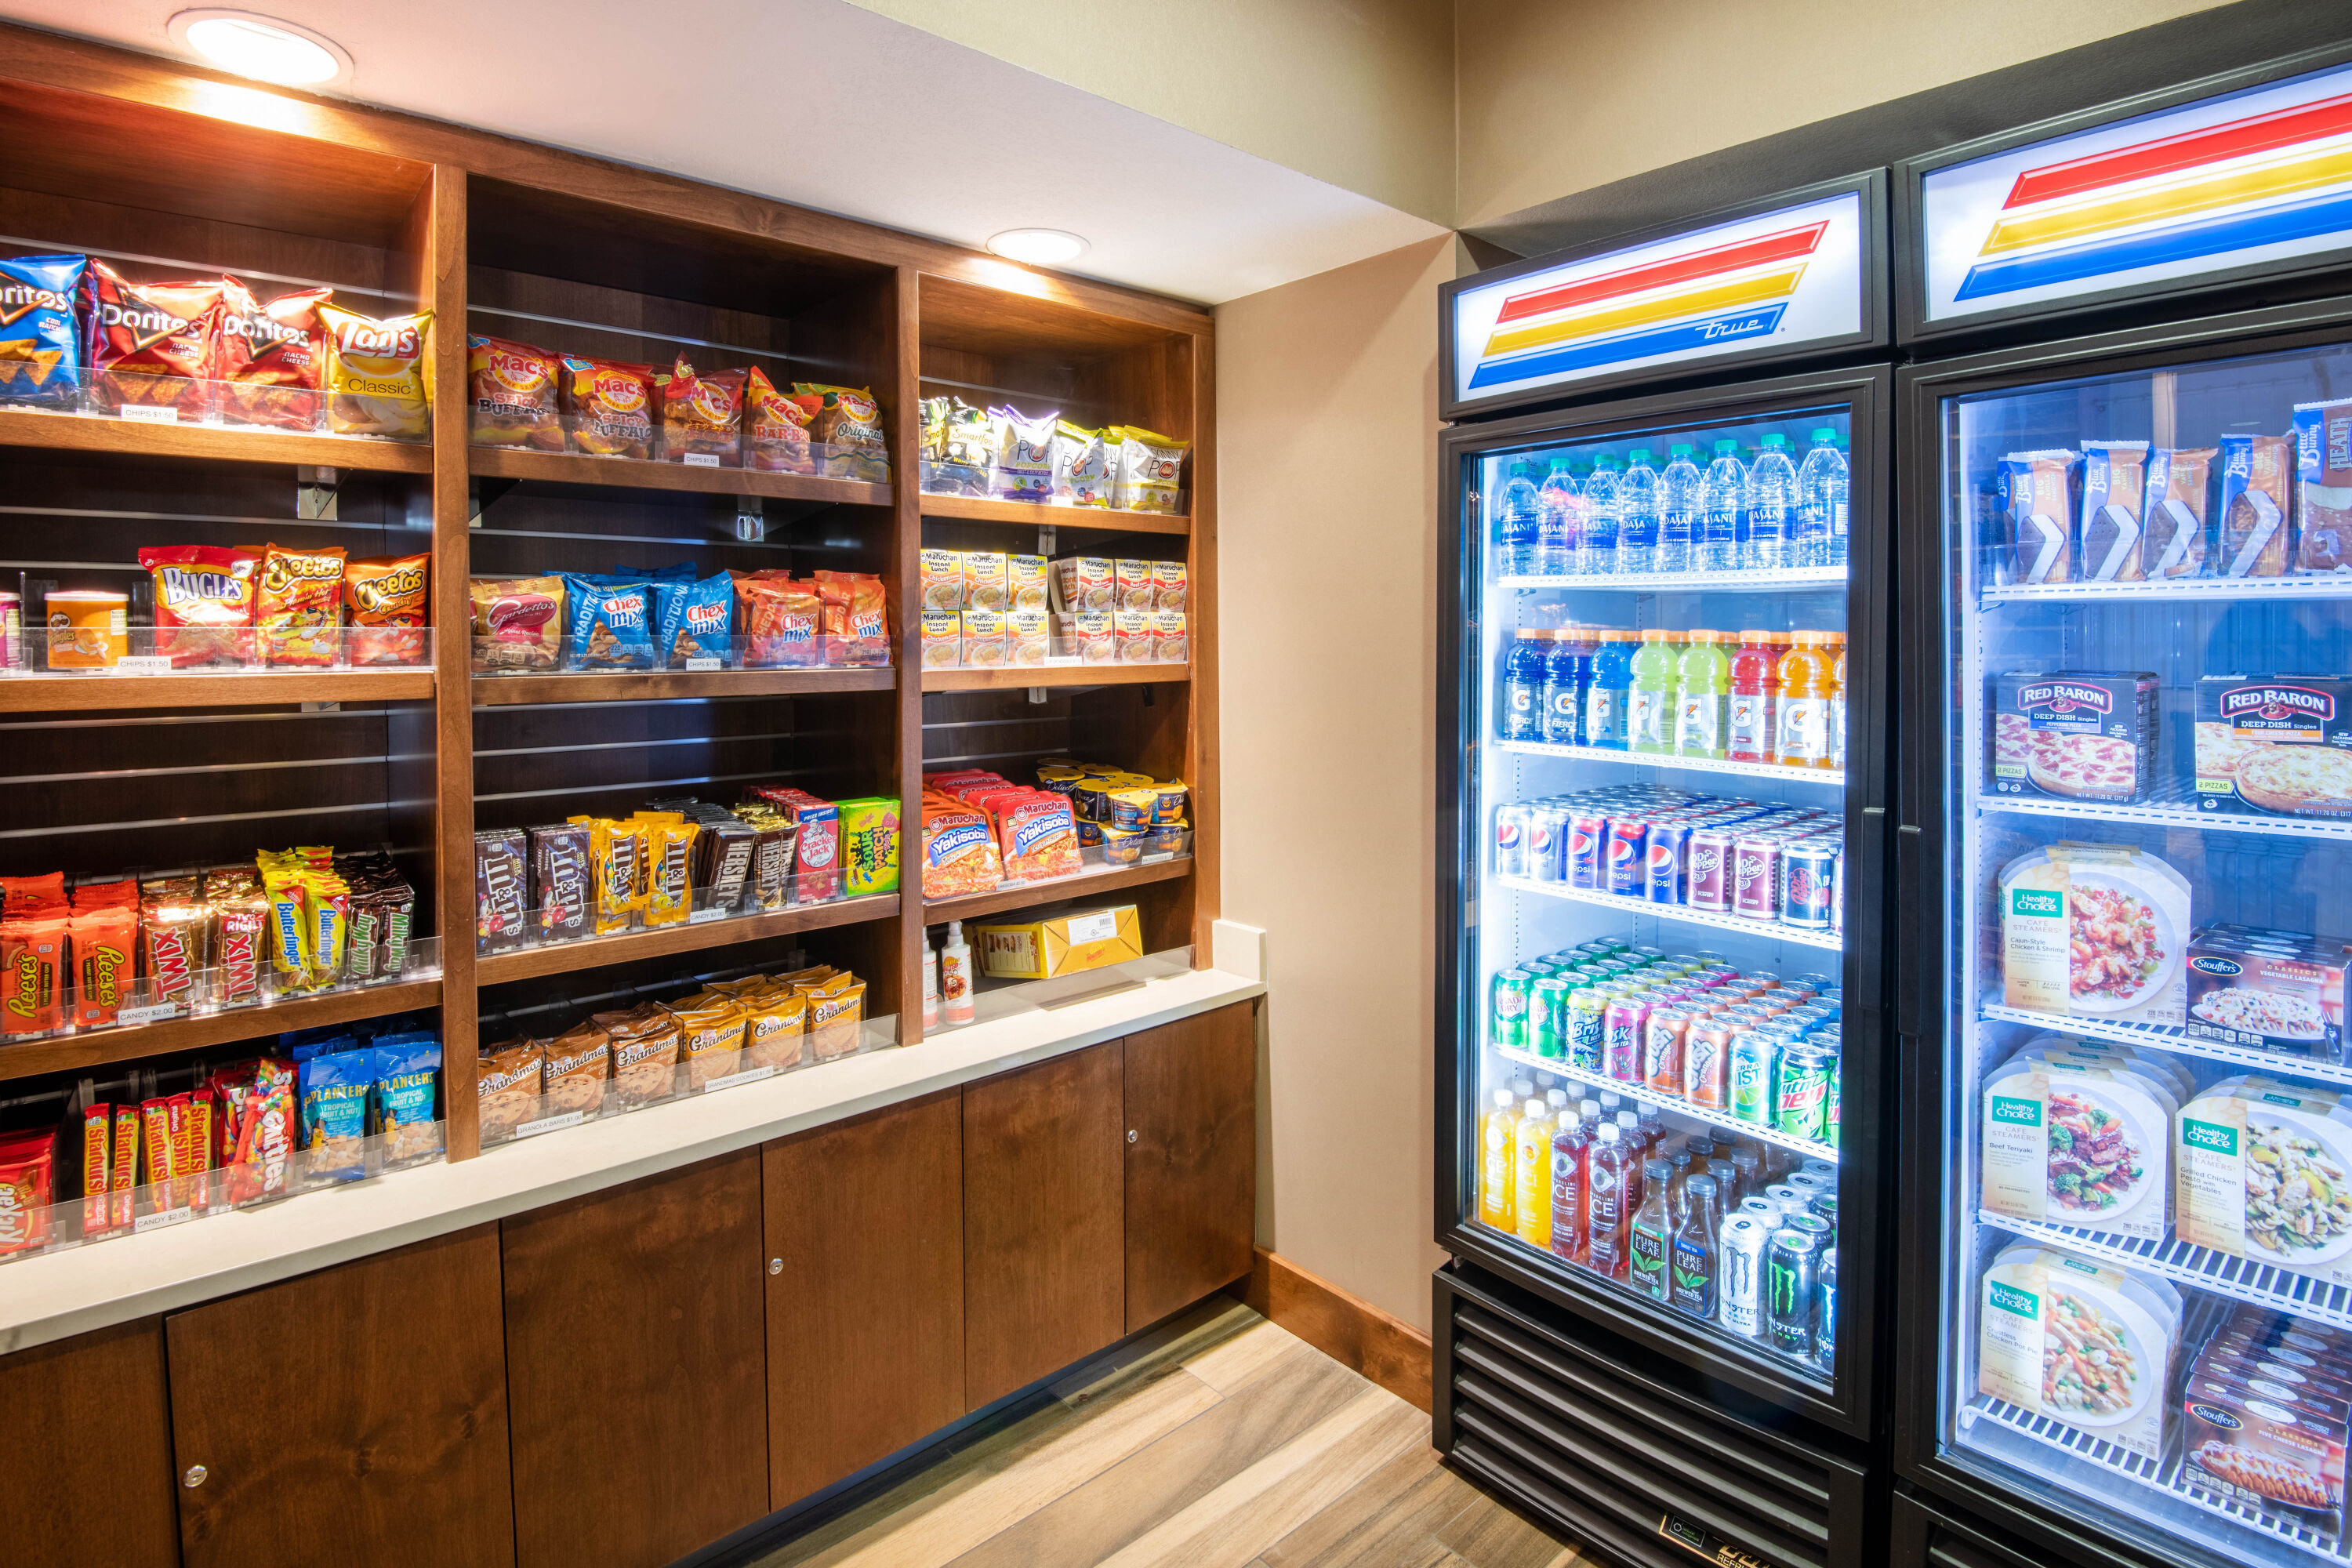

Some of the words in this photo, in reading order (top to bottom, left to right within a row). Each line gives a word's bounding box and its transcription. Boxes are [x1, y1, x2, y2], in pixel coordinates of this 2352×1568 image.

[102, 303, 202, 338] Doritos
[223, 315, 310, 346] Doritos
[281, 357, 310, 366] CHEESE
[488, 354, 549, 379] Mac's
[348, 379, 412, 396] Classic
[592, 378, 647, 398] Mac's
[760, 394, 803, 426] Mac's
[837, 392, 877, 412] Mac's
[125, 408, 151, 417] CHIPS
[601, 414, 644, 426] SPICY
[837, 422, 884, 441] Original
[926, 553, 958, 562] Maruchan
[1086, 560, 1111, 568] Maruchan
[161, 567, 243, 605] BUGLES
[354, 568, 424, 612] Cheetos
[379, 595, 413, 614] Crunchy
[604, 596, 643, 614] Chex
[687, 601, 727, 621] Chex
[486, 599, 554, 635] Gardetto's
[781, 613, 817, 631] Chex
[851, 611, 881, 628] Chex
[2024, 688, 2052, 703] RED
[2053, 685, 2105, 706] BARON
[2229, 693, 2262, 710] RED
[2263, 690, 2325, 711] BARON
[1025, 802, 1068, 814] Maruchan
[804, 813, 817, 822] PRIZE
[939, 815, 985, 825] Maruchan
[1018, 816, 1070, 844] Yakisoba
[800, 835, 837, 853] Cracker
[873, 826, 884, 870] PATCH
[931, 828, 987, 855] Yakisoba
[807, 846, 829, 861] Jack
[862, 831, 873, 871] SOUR
[715, 840, 755, 909] HERSHEY'S
[761, 841, 781, 898] HERSHEY'S
[2017, 902, 2056, 912] Choice
[2022, 895, 2056, 906] Healthy
[277, 902, 301, 967] Butterfinger
[316, 909, 336, 965] Butterfinger
[2013, 924, 2060, 934] STEAMERS
[2010, 937, 2045, 946] Cajun-Style
[2042, 945, 2066, 954] Shrimp
[2197, 959, 2237, 973] Stouffer's
[2259, 970, 2294, 980] VEGETABLE
[2267, 964, 2318, 976] CLASSICS
[7, 953, 38, 1018] Reese's
[96, 946, 125, 1007] Reese's
[120, 1010, 149, 1020] CANDY
[151, 1007, 173, 1016] $2.00
[689, 1022, 746, 1052] Grandma's
[615, 1035, 678, 1067] Grandma's
[1658, 1044, 1671, 1069] Orange
[546, 1044, 609, 1079] Grandma's
[1699, 1058, 1713, 1083] Orange
[379, 1072, 434, 1092] PLANTERS
[477, 1058, 542, 1097] Grandma's
[706, 1078, 735, 1089] GRANDMAS
[310, 1085, 369, 1102] PLANTERS
[393, 1088, 423, 1099] TROPICAL
[323, 1101, 355, 1110] TROPICAL
[1996, 1108, 2036, 1120] Choice
[2001, 1101, 2034, 1113] Healthy
[517, 1123, 547, 1135] GRANOLA
[549, 1118, 566, 1128] BARS
[566, 1114, 583, 1123] $1.00
[2193, 1125, 2230, 1140] Healthy
[149, 1115, 172, 1182] Starburst
[2006, 1145, 2033, 1154] Teriyaki
[2187, 1132, 2230, 1149] Choice
[88, 1127, 107, 1195] Starburst
[115, 1123, 135, 1189] Starburst
[2180, 1167, 2205, 1178] Grilled
[2207, 1174, 2237, 1185] Chicken
[2180, 1173, 2201, 1184] Pesto
[2180, 1181, 2222, 1196] Vegetables
[123, 1194, 132, 1224] Original
[1591, 1196, 1615, 1217] ICE
[137, 1216, 166, 1228] CANDY
[168, 1210, 189, 1221] $2.00
[1635, 1242, 1660, 1257] LEAF
[1636, 1234, 1660, 1248] PURE
[1676, 1250, 1703, 1265] PURE
[1677, 1258, 1702, 1272] LEAF
[1650, 1276, 1659, 1285] TEA
[1676, 1287, 1693, 1299] BREWED
[1693, 1294, 1703, 1303] TEA
[1994, 1294, 2033, 1314] Choice
[1998, 1287, 2032, 1305] Healthy
[1987, 1326, 2016, 1340] Crustless
[1987, 1332, 2013, 1346] Chicken
[2013, 1341, 2026, 1350] Pot
[2198, 1406, 2237, 1427] Stouffer's
[2274, 1434, 2296, 1447] CHEESE
